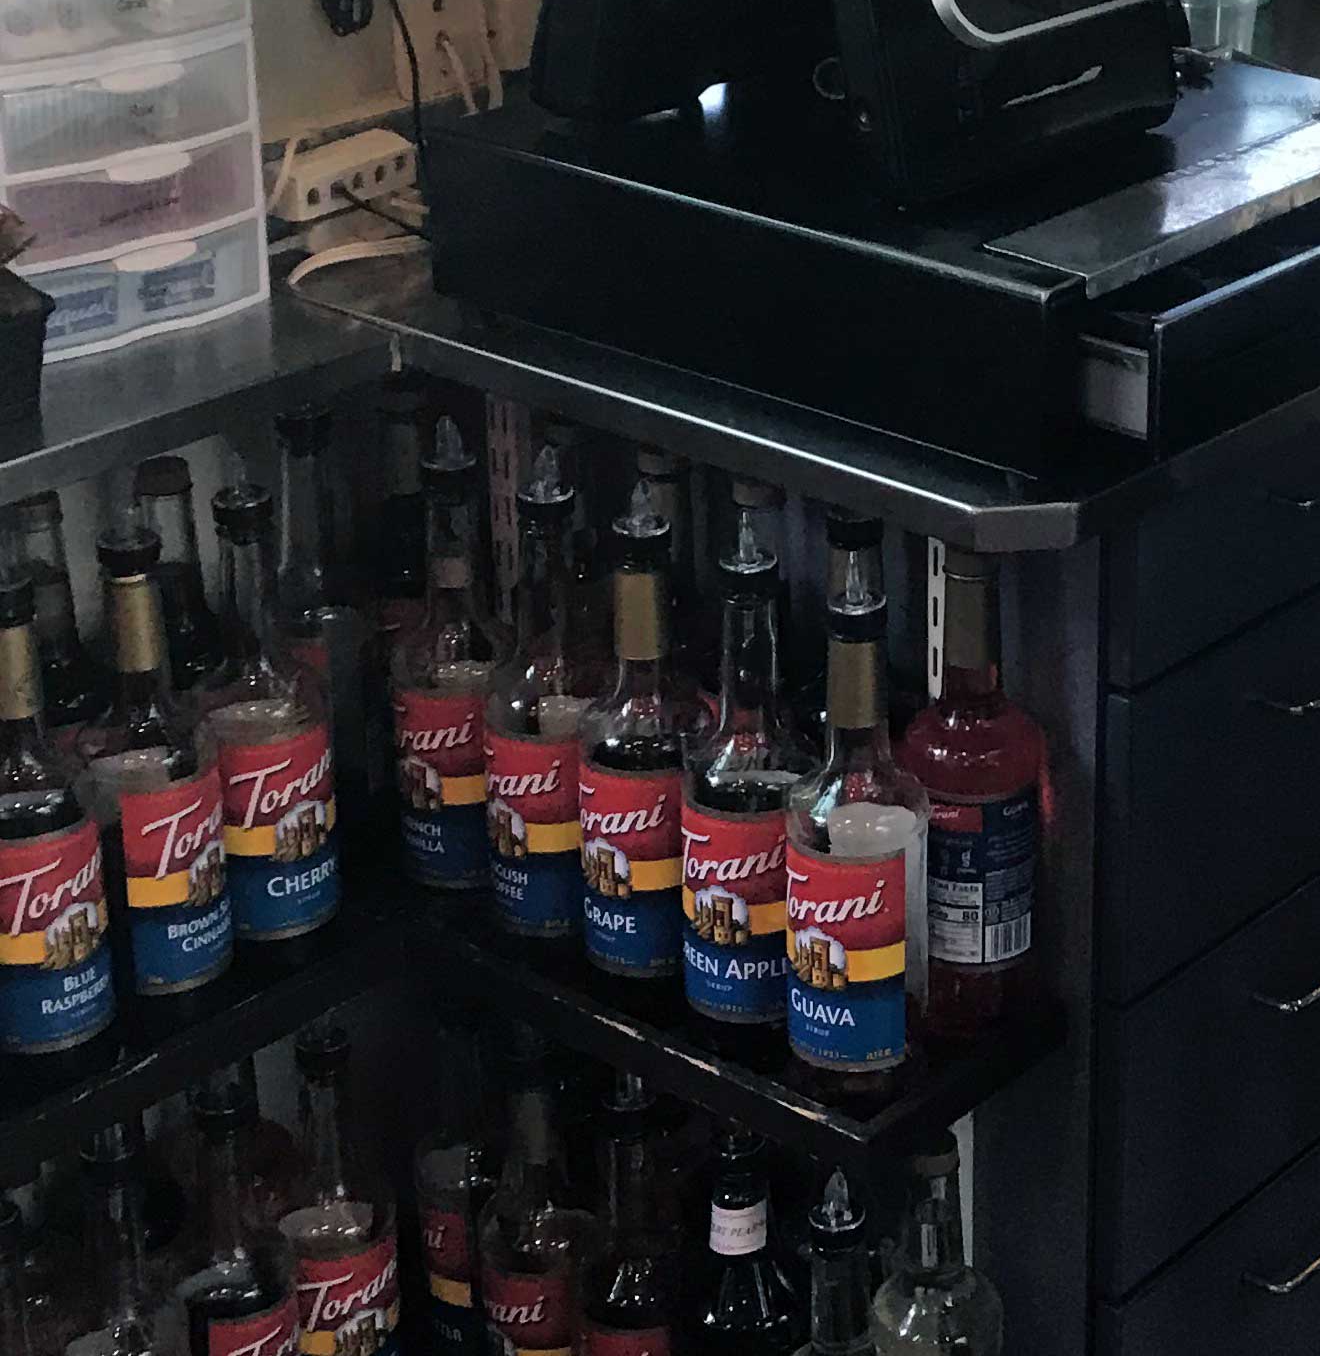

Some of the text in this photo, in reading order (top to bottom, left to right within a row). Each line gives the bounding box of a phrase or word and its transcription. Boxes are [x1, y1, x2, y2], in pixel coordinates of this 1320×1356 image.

[399, 712, 475, 752] rani
[487, 758, 561, 797] rani
[681, 825, 787, 884] Torani
[267, 857, 337, 898] CHERRY
[785, 864, 887, 924] Torani
[167, 907, 219, 941] BROWN
[583, 896, 638, 935] GRAPE
[961, 909, 980, 923] 80
[62, 964, 98, 993] BLUE
[790, 987, 857, 1028] GUAVA
